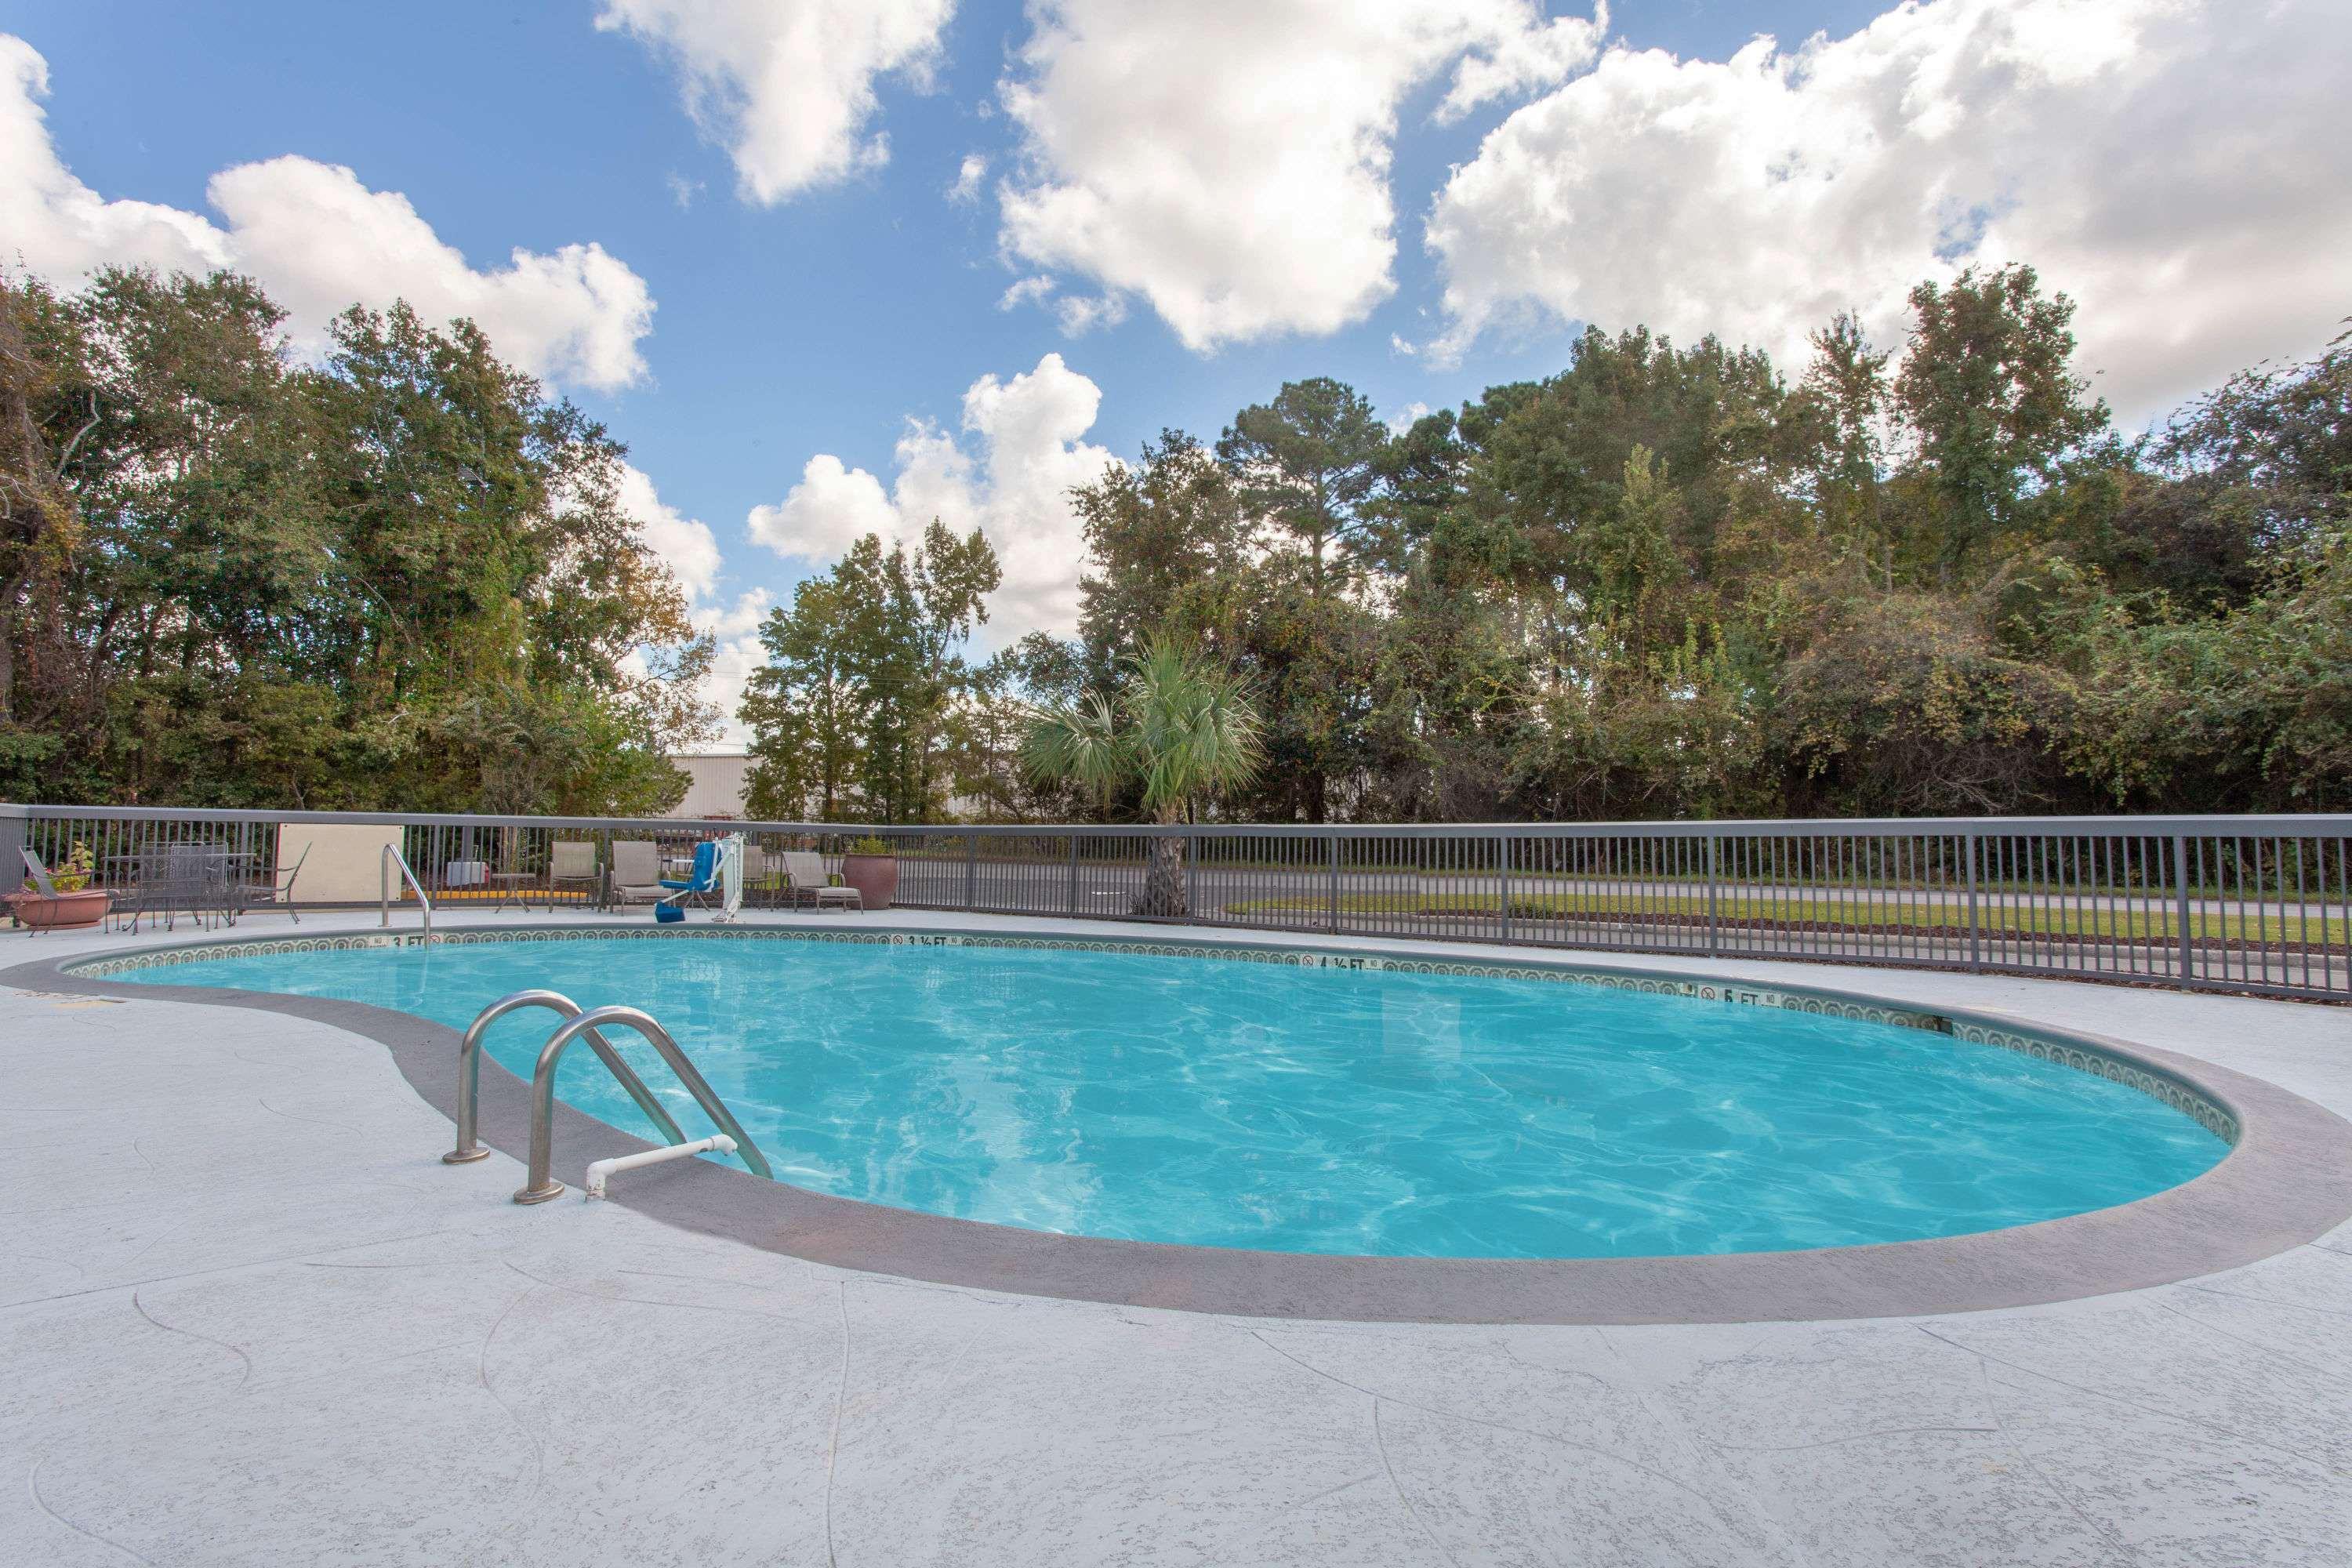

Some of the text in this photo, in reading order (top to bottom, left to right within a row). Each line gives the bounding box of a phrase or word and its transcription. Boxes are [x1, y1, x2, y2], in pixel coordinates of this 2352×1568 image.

[394, 935, 424, 946] 3 FT
[909, 935, 915, 946] 3
[934, 936, 946, 946] FT
[1320, 956, 1327, 967] 4
[1350, 958, 1364, 970] FT
[1724, 989, 1758, 1005] 5 FT
